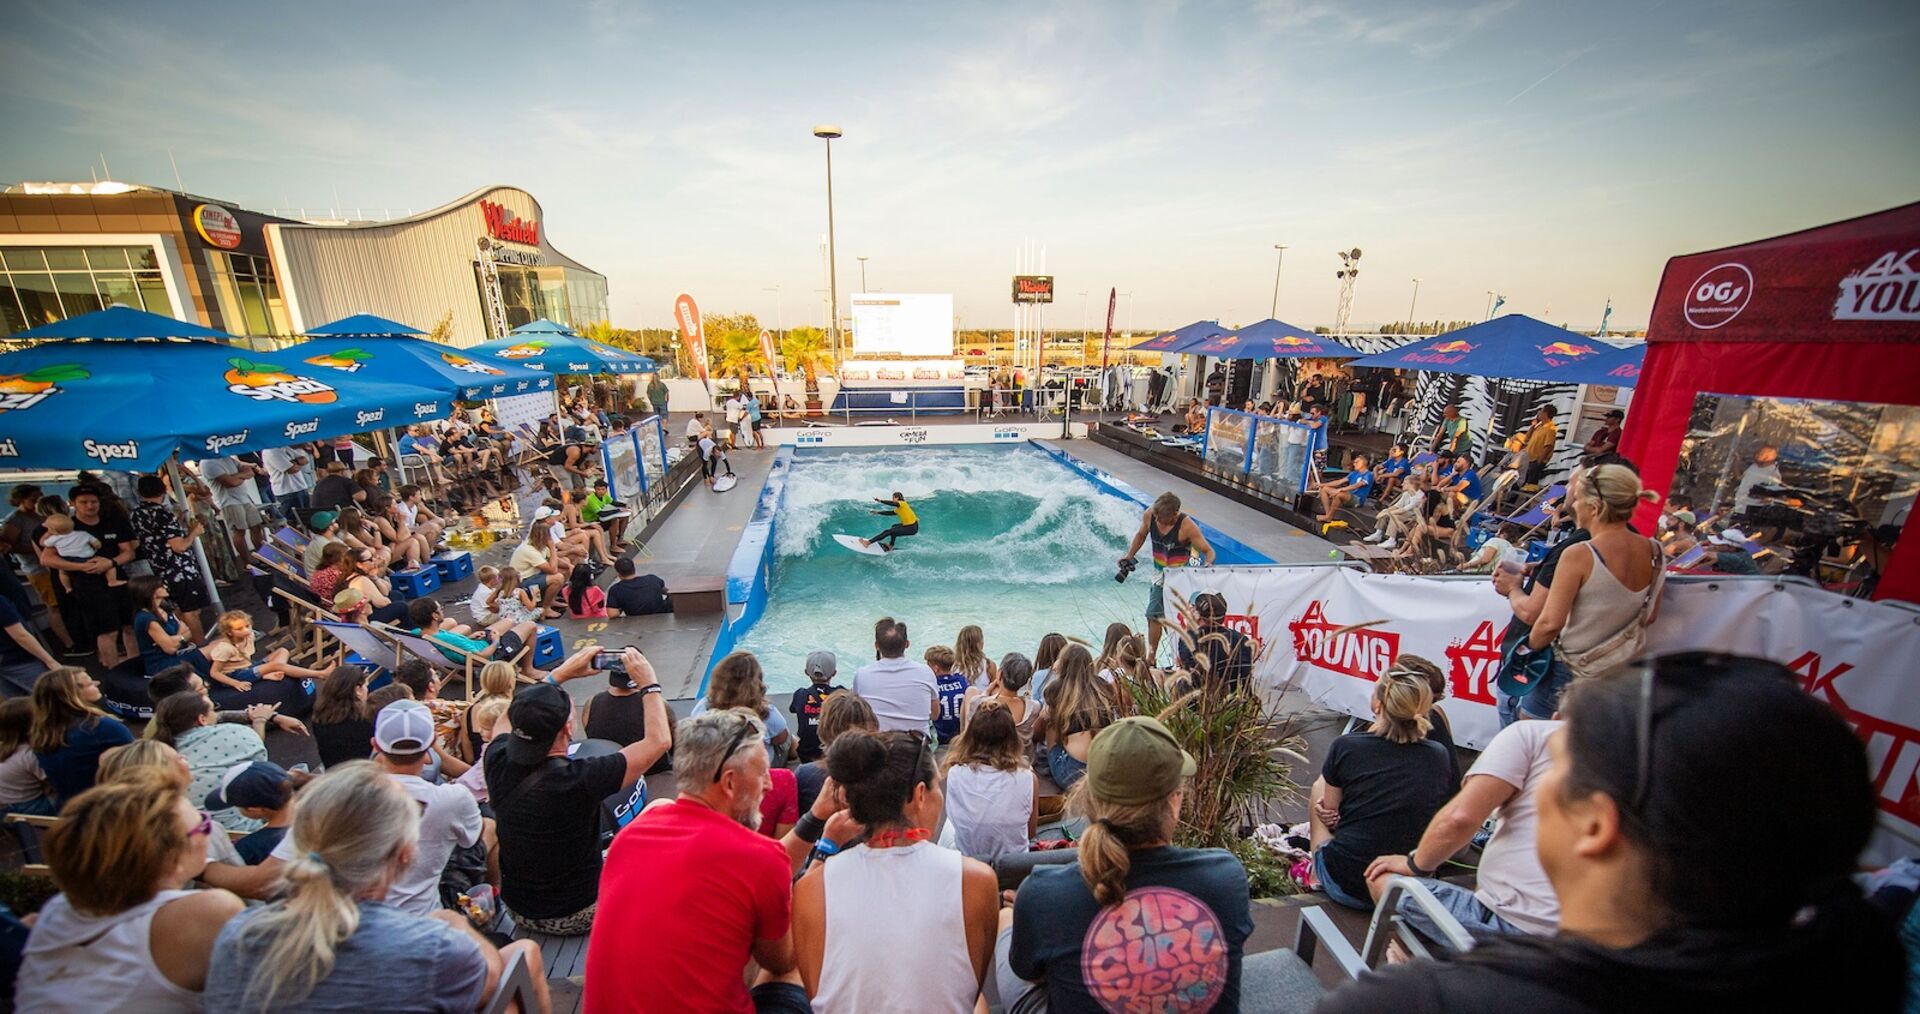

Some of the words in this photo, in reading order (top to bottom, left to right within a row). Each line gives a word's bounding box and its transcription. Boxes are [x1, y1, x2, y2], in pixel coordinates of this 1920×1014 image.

[480, 200, 539, 246] Westfield
[228, 376, 336, 403] Spezi
[356, 408, 384, 427] Spezi
[413, 401, 437, 418] Spezi
[284, 417, 318, 439] Spezi
[83, 438, 139, 464] Spezi
[205, 429, 248, 454] Spezi
[1300, 627, 1391, 678] YOUNG
[938, 681, 963, 692] MESSI
[1094, 894, 1200, 950] RIP
[1092, 920, 1223, 981] CURL
